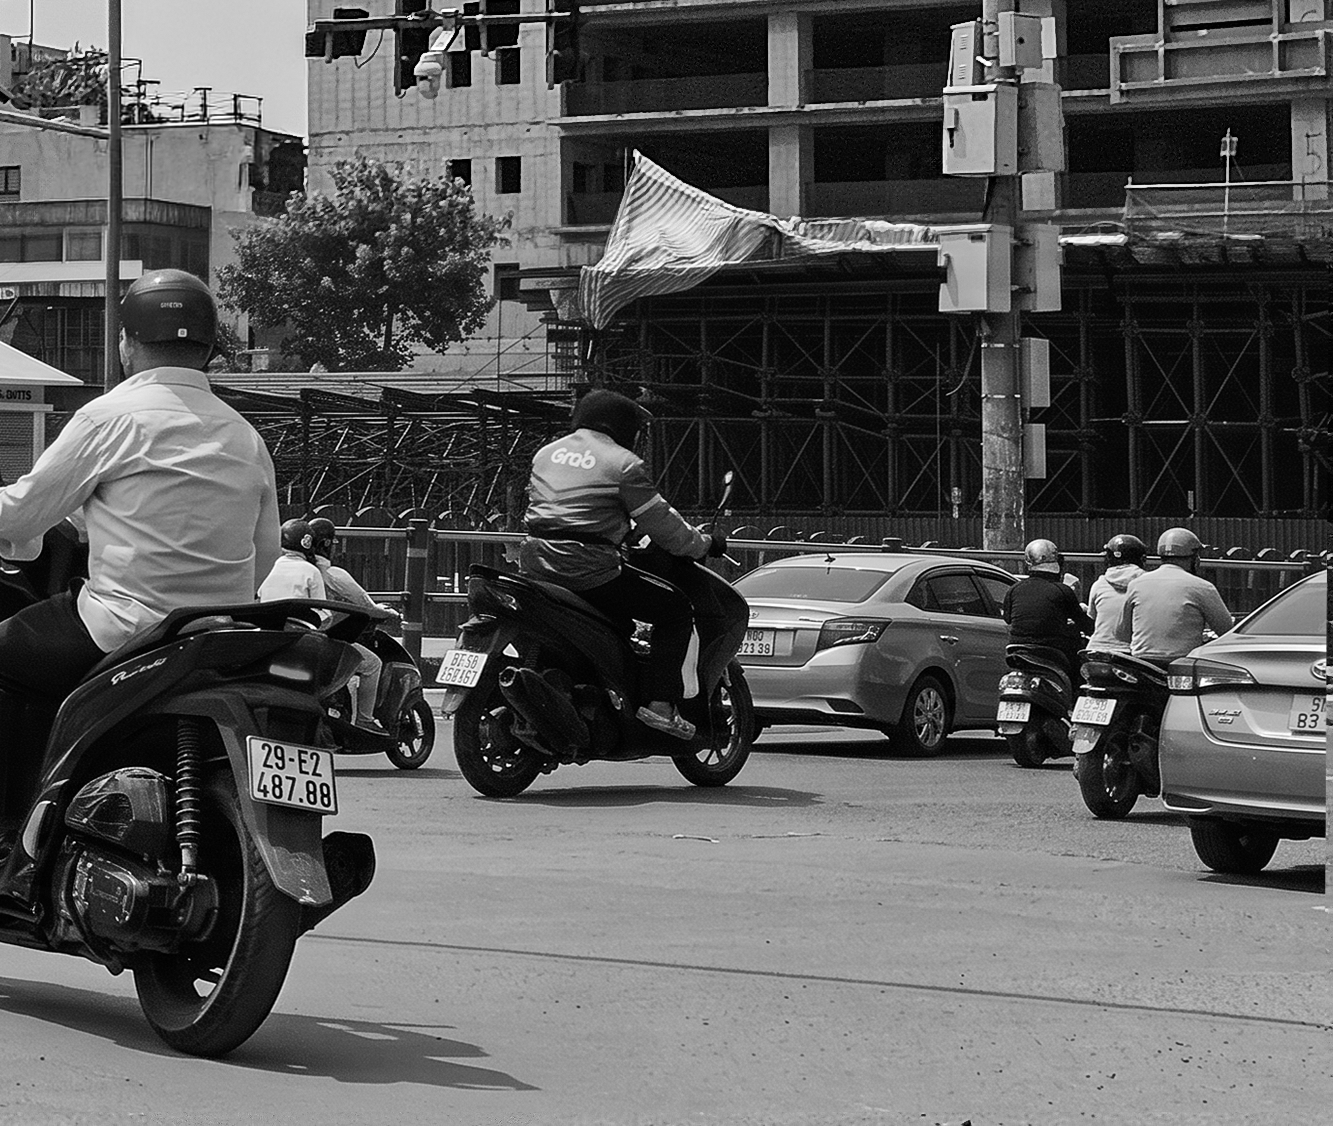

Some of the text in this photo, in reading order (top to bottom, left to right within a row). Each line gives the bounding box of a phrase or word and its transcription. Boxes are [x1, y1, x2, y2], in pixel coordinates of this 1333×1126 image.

[551, 447, 596, 470] Grab
[261, 743, 322, 777] 29-E2
[257, 771, 331, 808] 487.88
